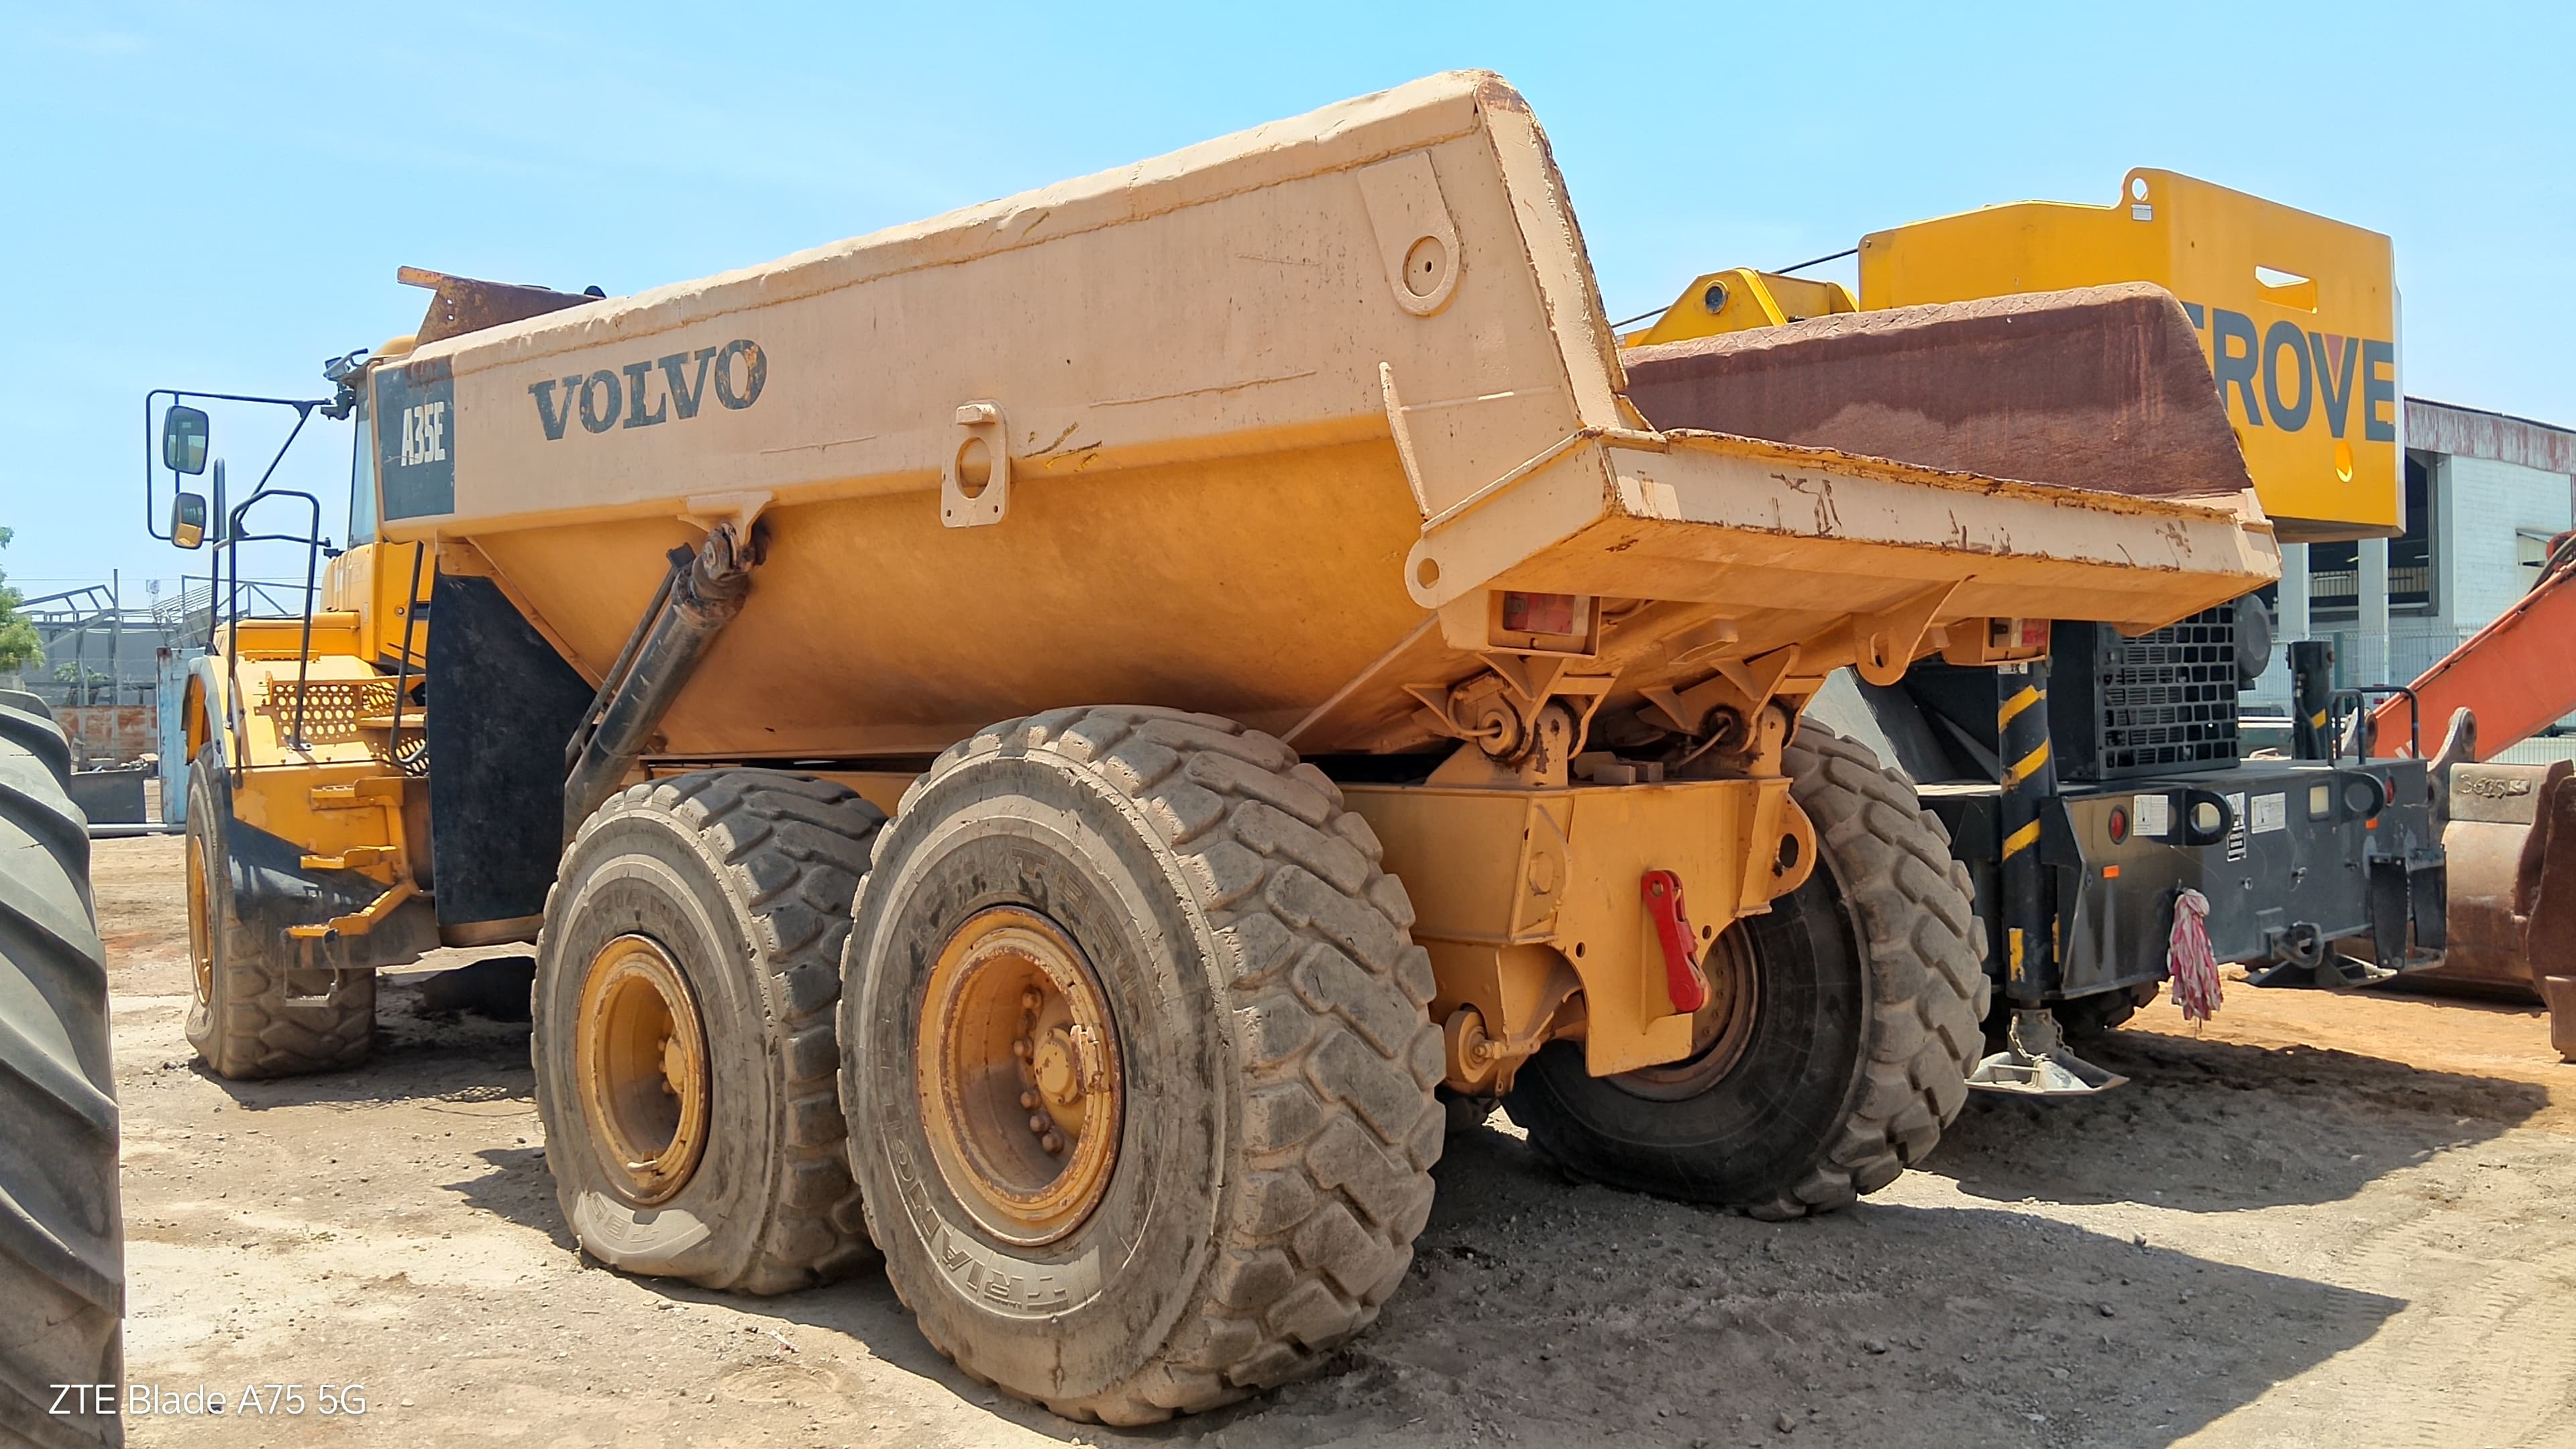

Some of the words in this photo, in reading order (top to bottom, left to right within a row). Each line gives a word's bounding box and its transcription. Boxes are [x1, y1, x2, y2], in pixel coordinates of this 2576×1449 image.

[528, 339, 767, 441] VOLVO
[2180, 301, 2395, 441] ROVE
[401, 400, 445, 467] A35E
